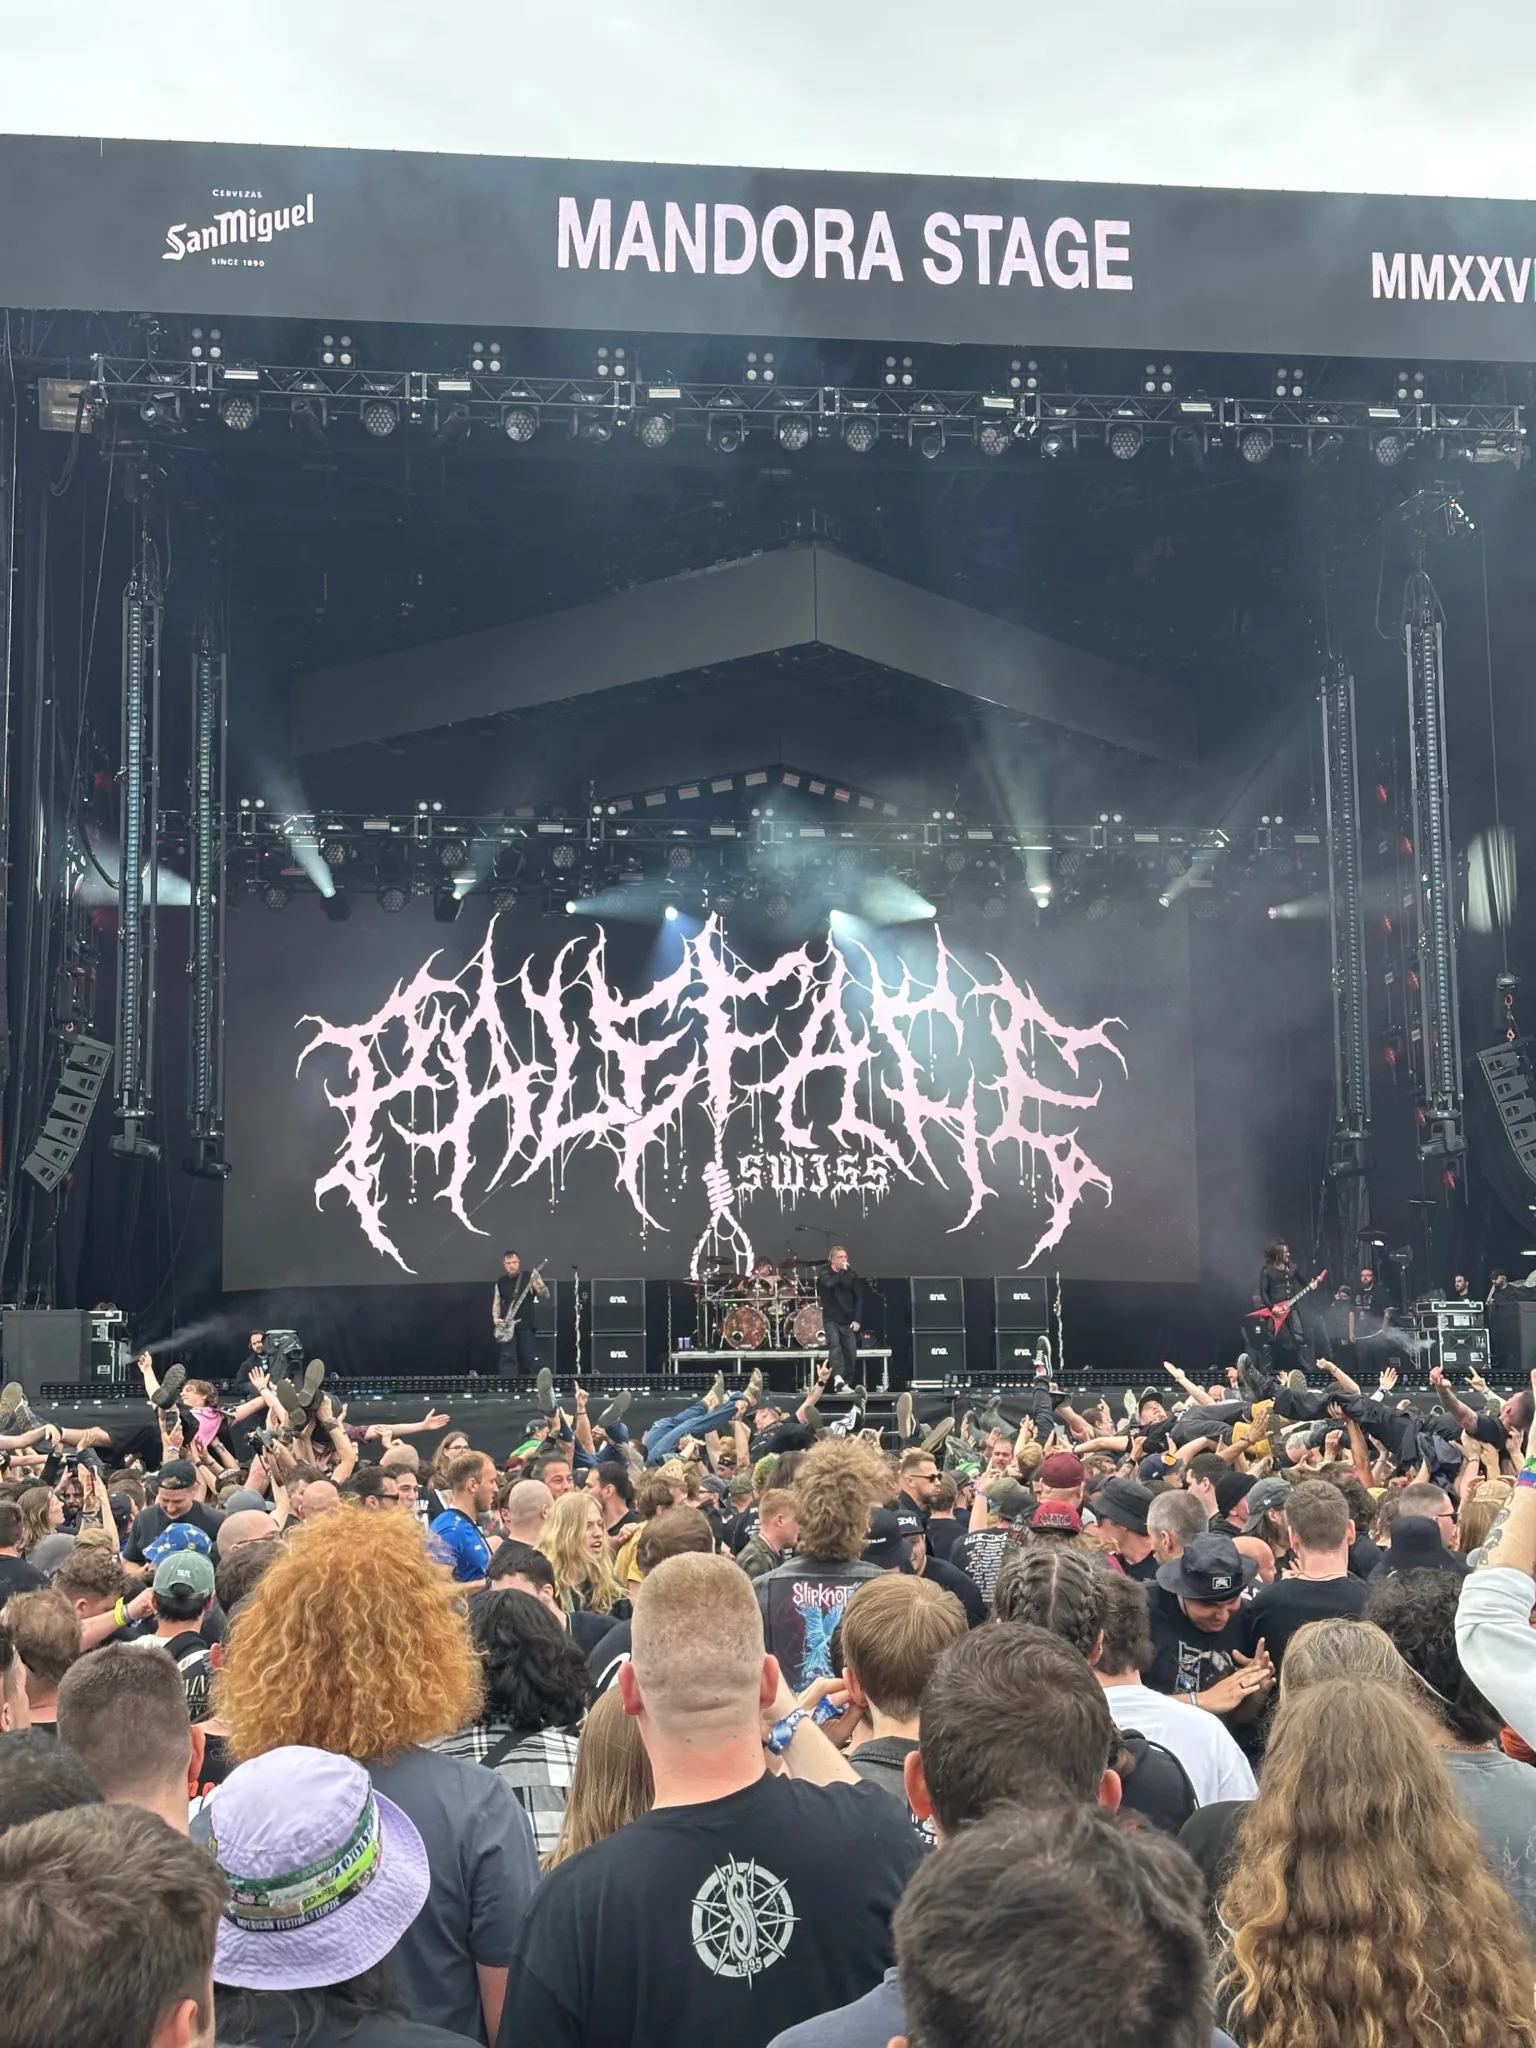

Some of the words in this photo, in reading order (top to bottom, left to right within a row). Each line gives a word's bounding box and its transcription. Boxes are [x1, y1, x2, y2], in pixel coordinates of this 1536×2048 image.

[212, 188, 263, 198] CERVEZAS
[557, 196, 904, 282] MANDORA
[922, 211, 1134, 290] STAGE
[211, 257, 239, 266] SINCE
[242, 259, 265, 267] 1890
[1371, 251, 1536, 303] MMXXV
[733, 1150, 891, 1206] SWISS
[737, 1957, 762, 1974] 1995
